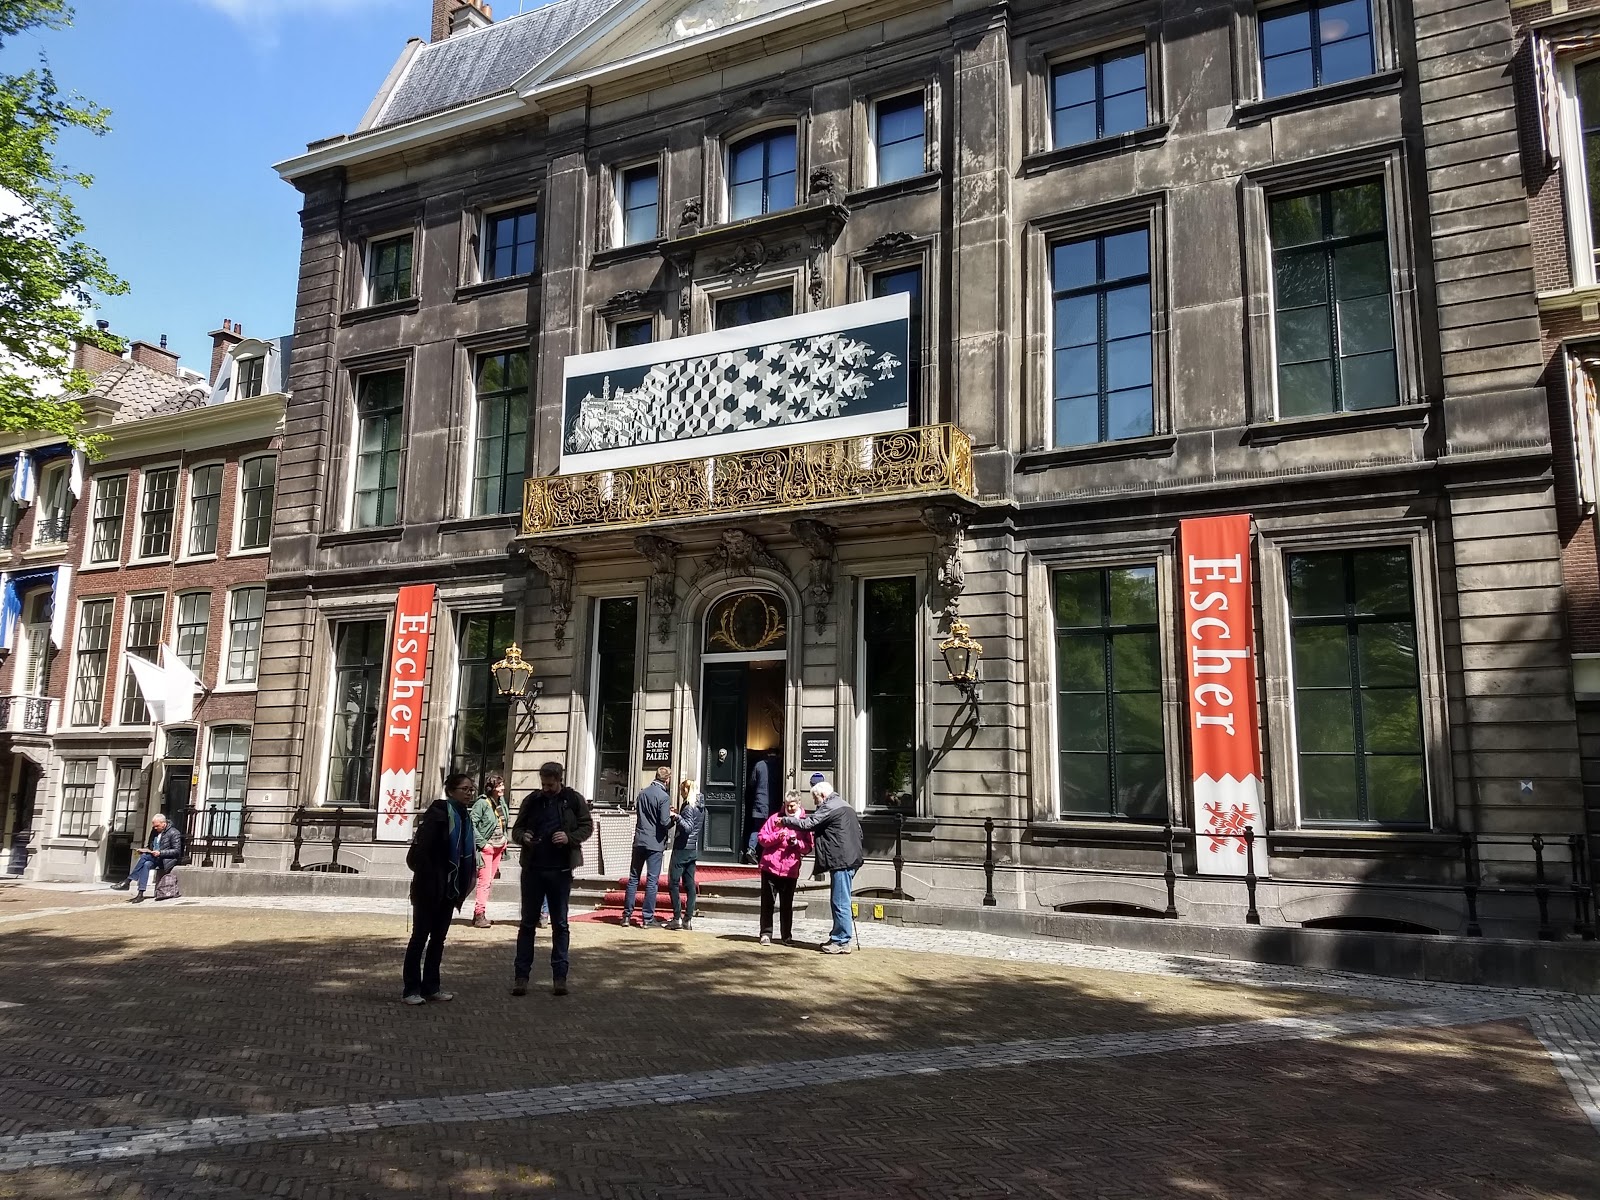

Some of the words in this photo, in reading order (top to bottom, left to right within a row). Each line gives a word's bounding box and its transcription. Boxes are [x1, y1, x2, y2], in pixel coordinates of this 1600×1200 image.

[389, 612, 429, 742] Escher
[1188, 553, 1250, 736] Escher
[646, 739, 670, 748] Escher
